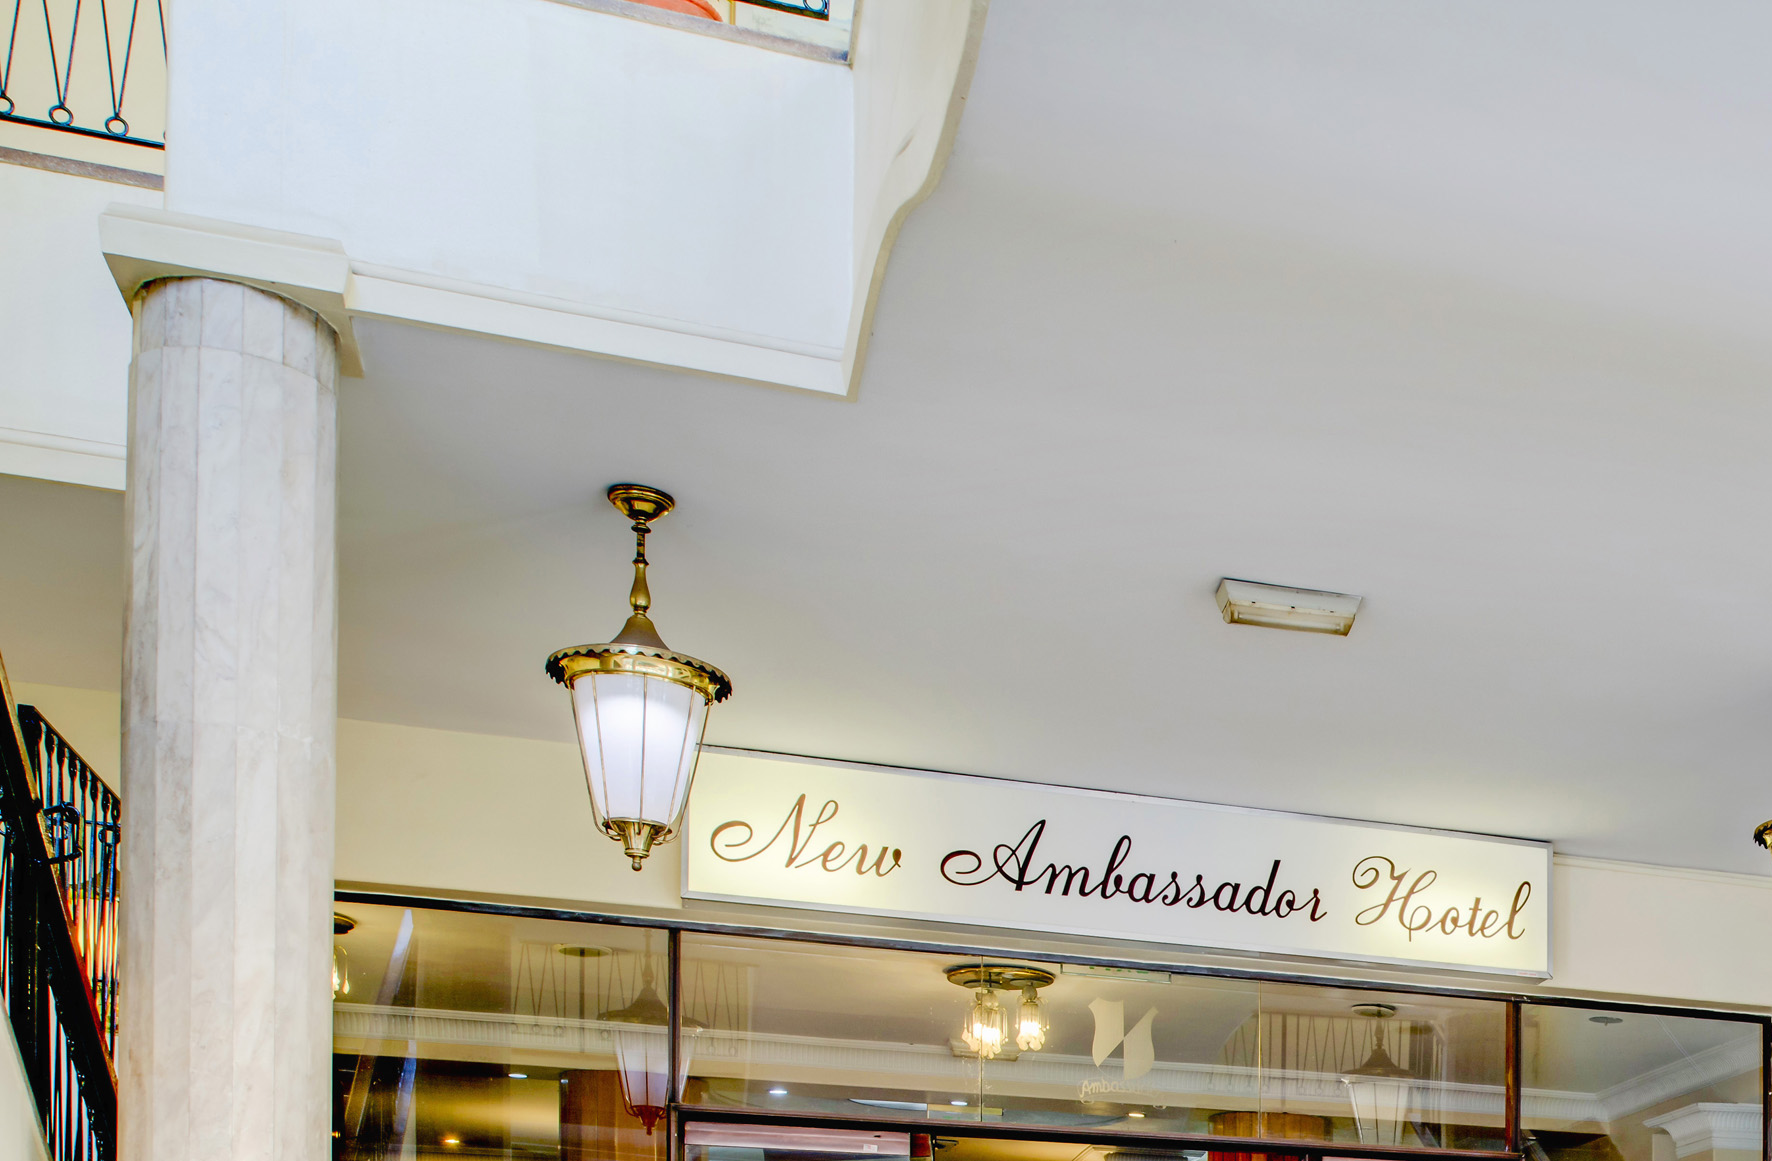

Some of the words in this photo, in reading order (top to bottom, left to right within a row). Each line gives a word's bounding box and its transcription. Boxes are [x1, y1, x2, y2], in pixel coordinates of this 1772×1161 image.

[710, 793, 902, 877] New
[940, 818, 1328, 923] Ambassador
[1352, 855, 1532, 942] Hotel
